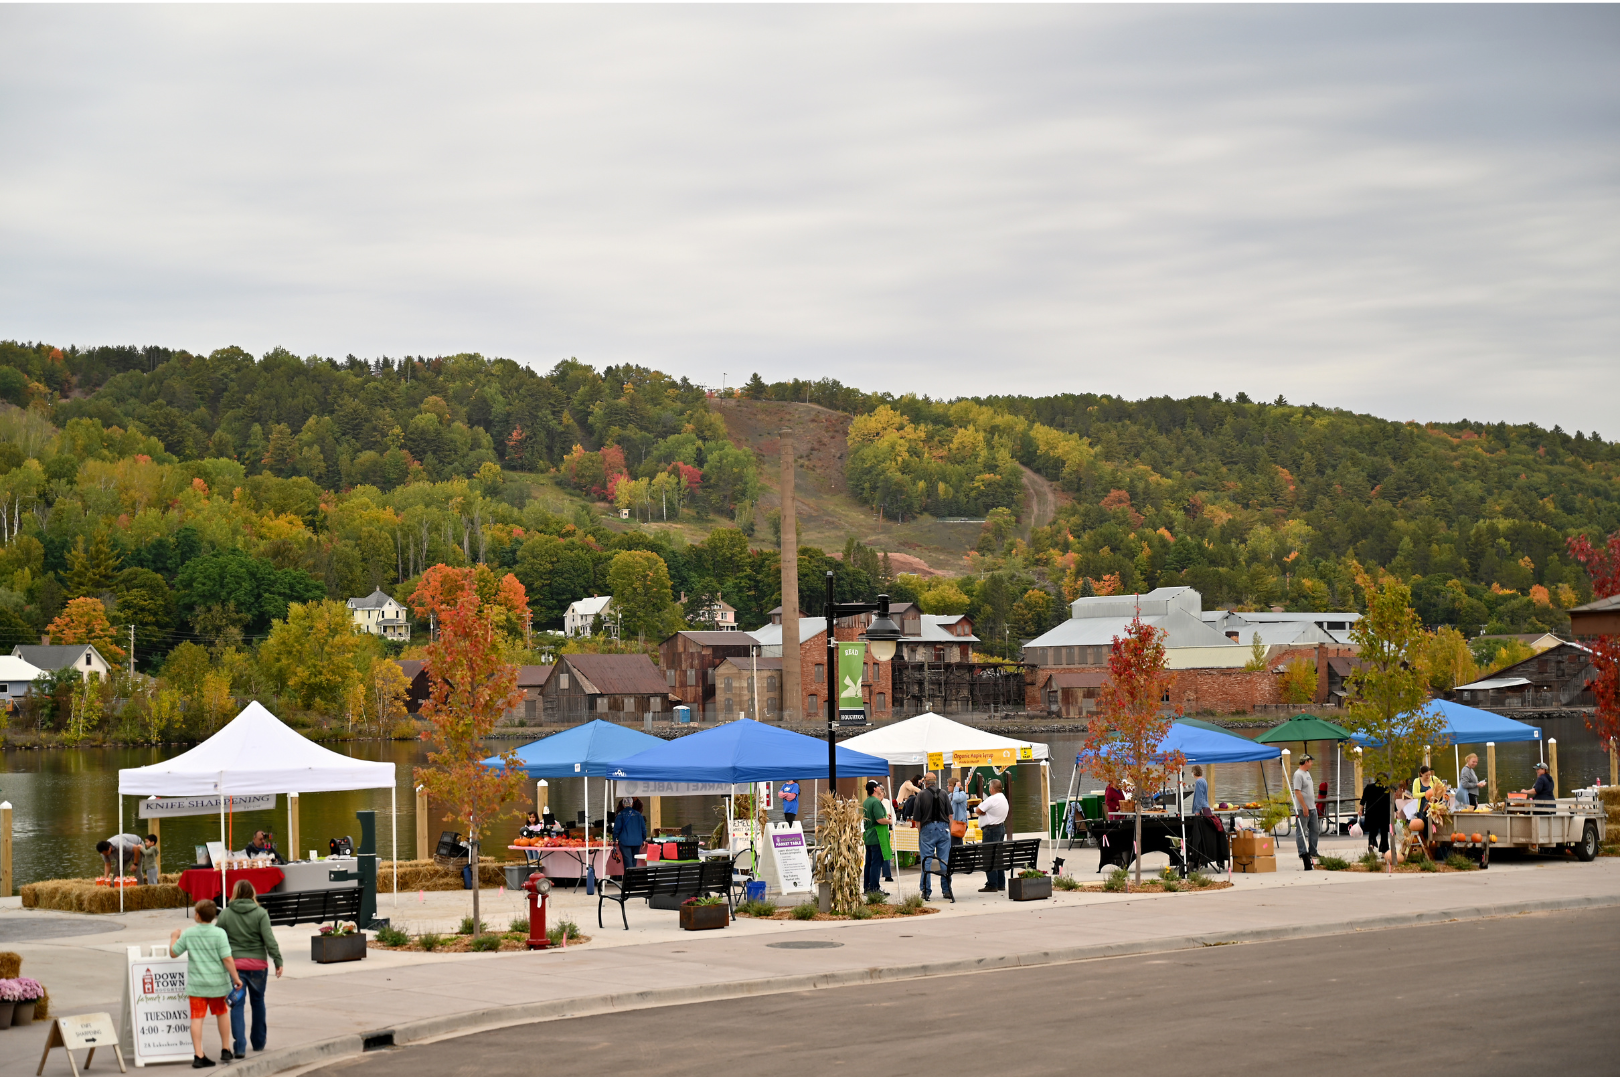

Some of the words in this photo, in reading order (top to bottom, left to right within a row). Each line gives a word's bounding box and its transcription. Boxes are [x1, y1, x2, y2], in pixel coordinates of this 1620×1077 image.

[146, 801, 185, 810] KNIFE
[188, 794, 270, 808] SHARPENING
[154, 972, 185, 980] DOWN
[137, 994, 165, 1005] farmer's
[144, 1010, 188, 1021] TUESDAYS
[140, 1025, 159, 1035] 4:00
